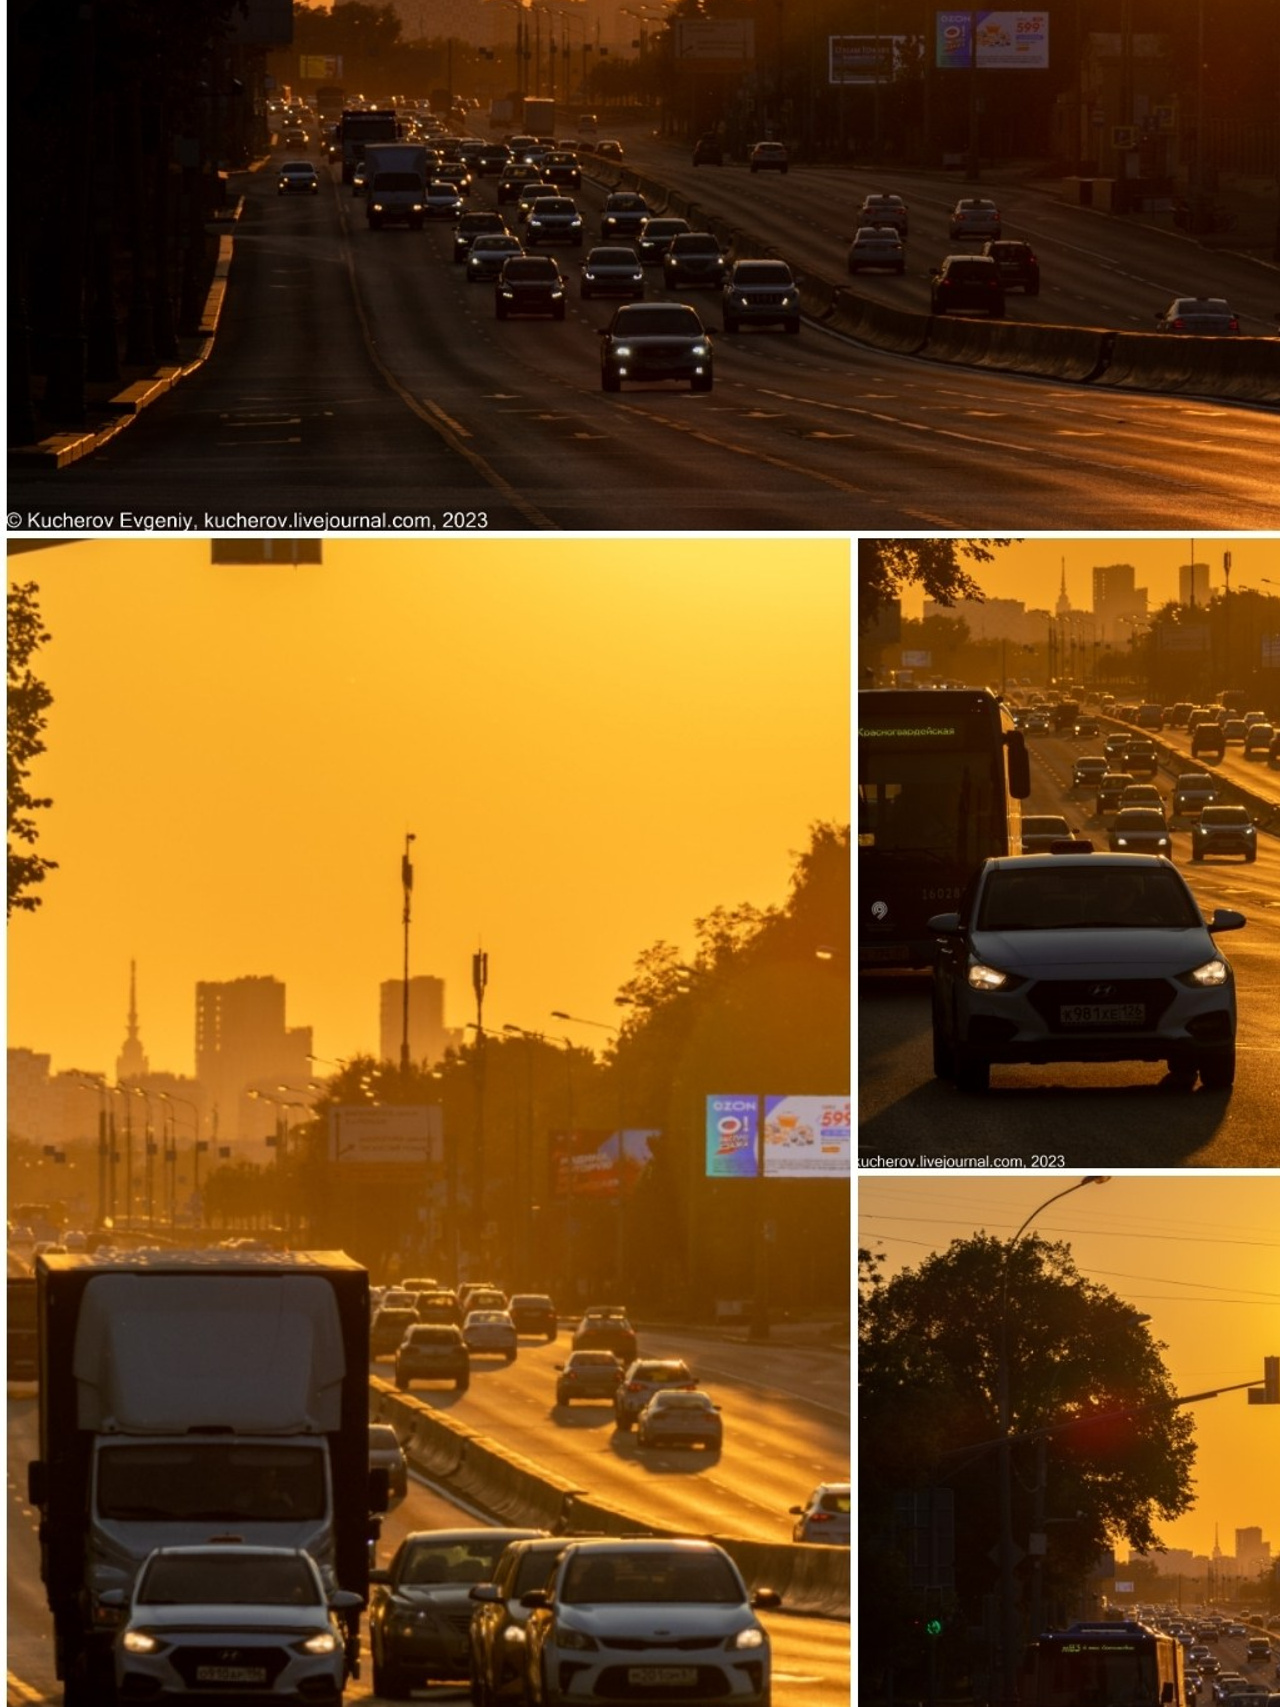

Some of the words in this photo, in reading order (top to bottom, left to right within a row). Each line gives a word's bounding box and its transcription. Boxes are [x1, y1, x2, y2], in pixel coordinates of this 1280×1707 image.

[1016, 22, 1040, 33] 599
[1064, 1006, 1119, 1021] К981ХЕ
[713, 1100, 757, 1112] OZON
